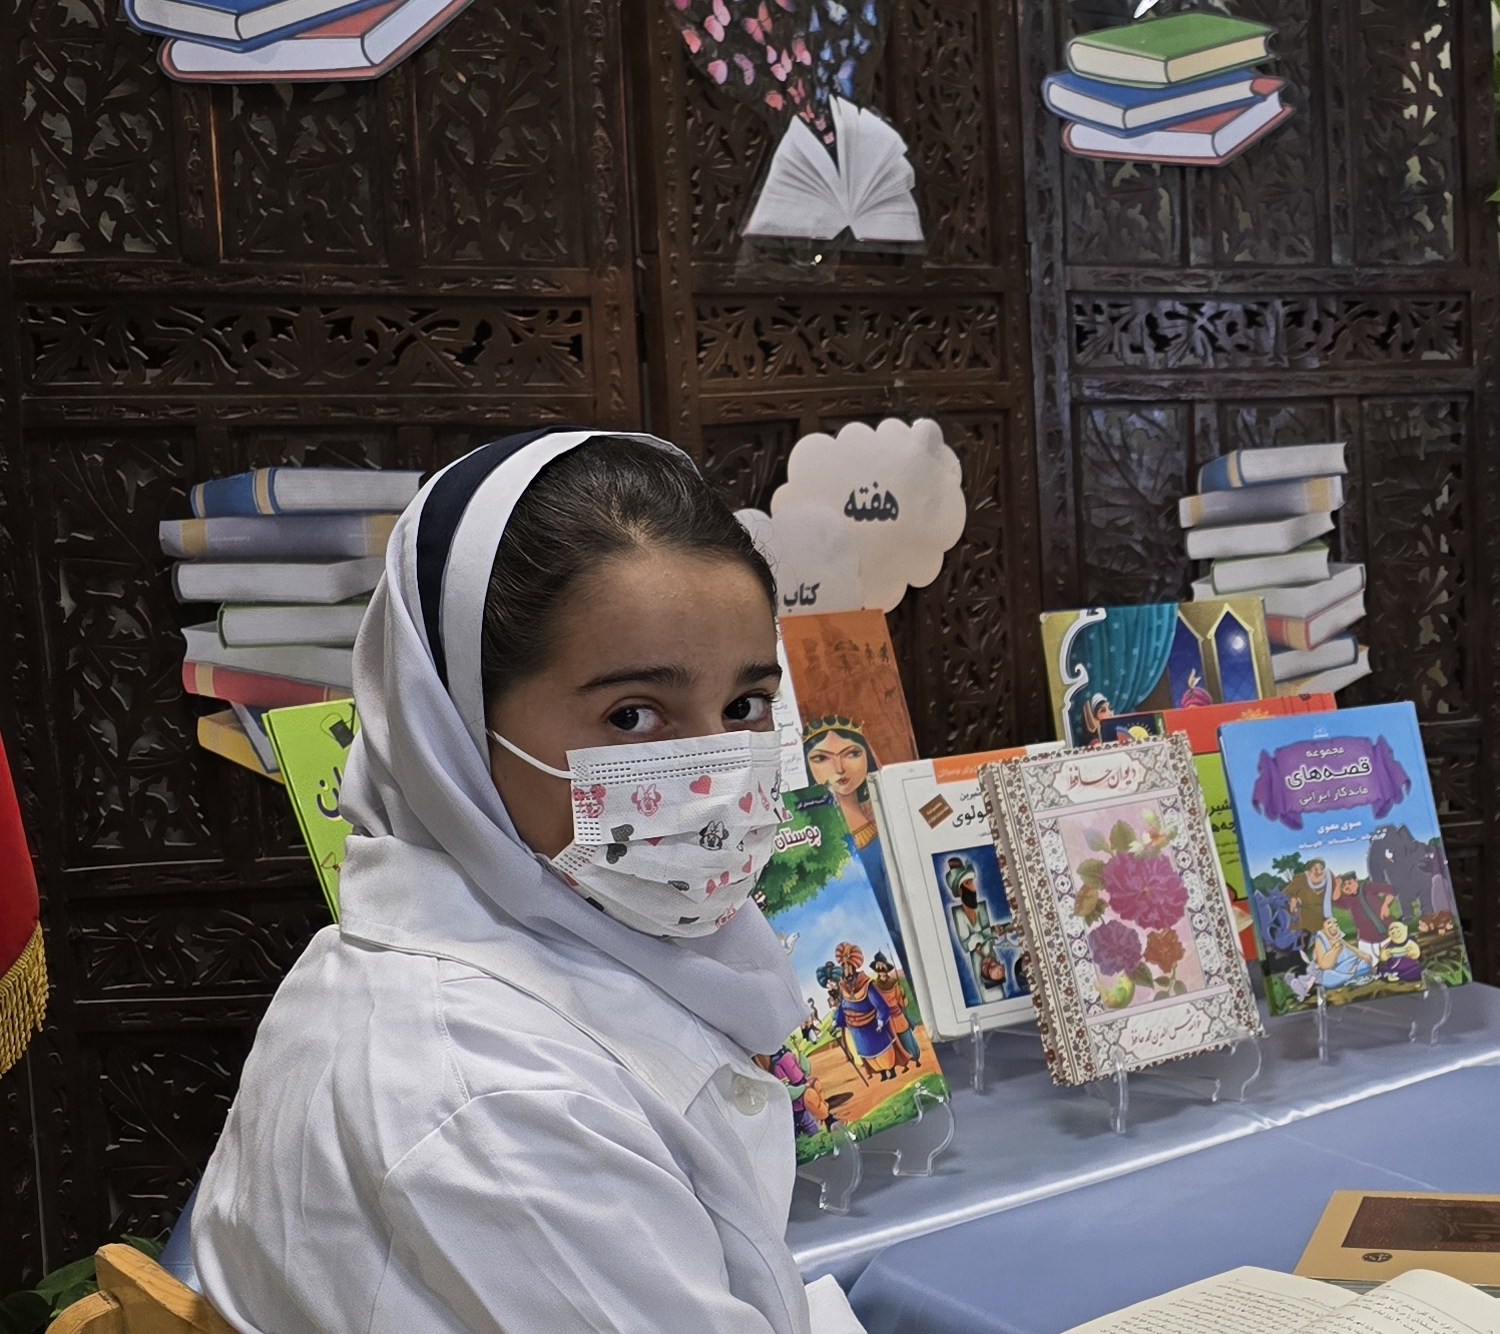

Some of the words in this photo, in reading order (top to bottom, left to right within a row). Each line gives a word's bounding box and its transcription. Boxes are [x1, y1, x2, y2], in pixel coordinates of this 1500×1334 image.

[844, 481, 899, 522] هفته
[783, 581, 820, 613] کتاب
[1306, 745, 1345, 759] مجموعه
[1067, 766, 1113, 791] حافظ
[1107, 765, 1137, 789] دیوان
[1299, 789, 1331, 806] ایرانی
[1333, 786, 1369, 801] ماندگار
[952, 805, 990, 828] ولوی
[774, 824, 822, 854] بوستان
[1131, 1028, 1146, 1046] حافظ
